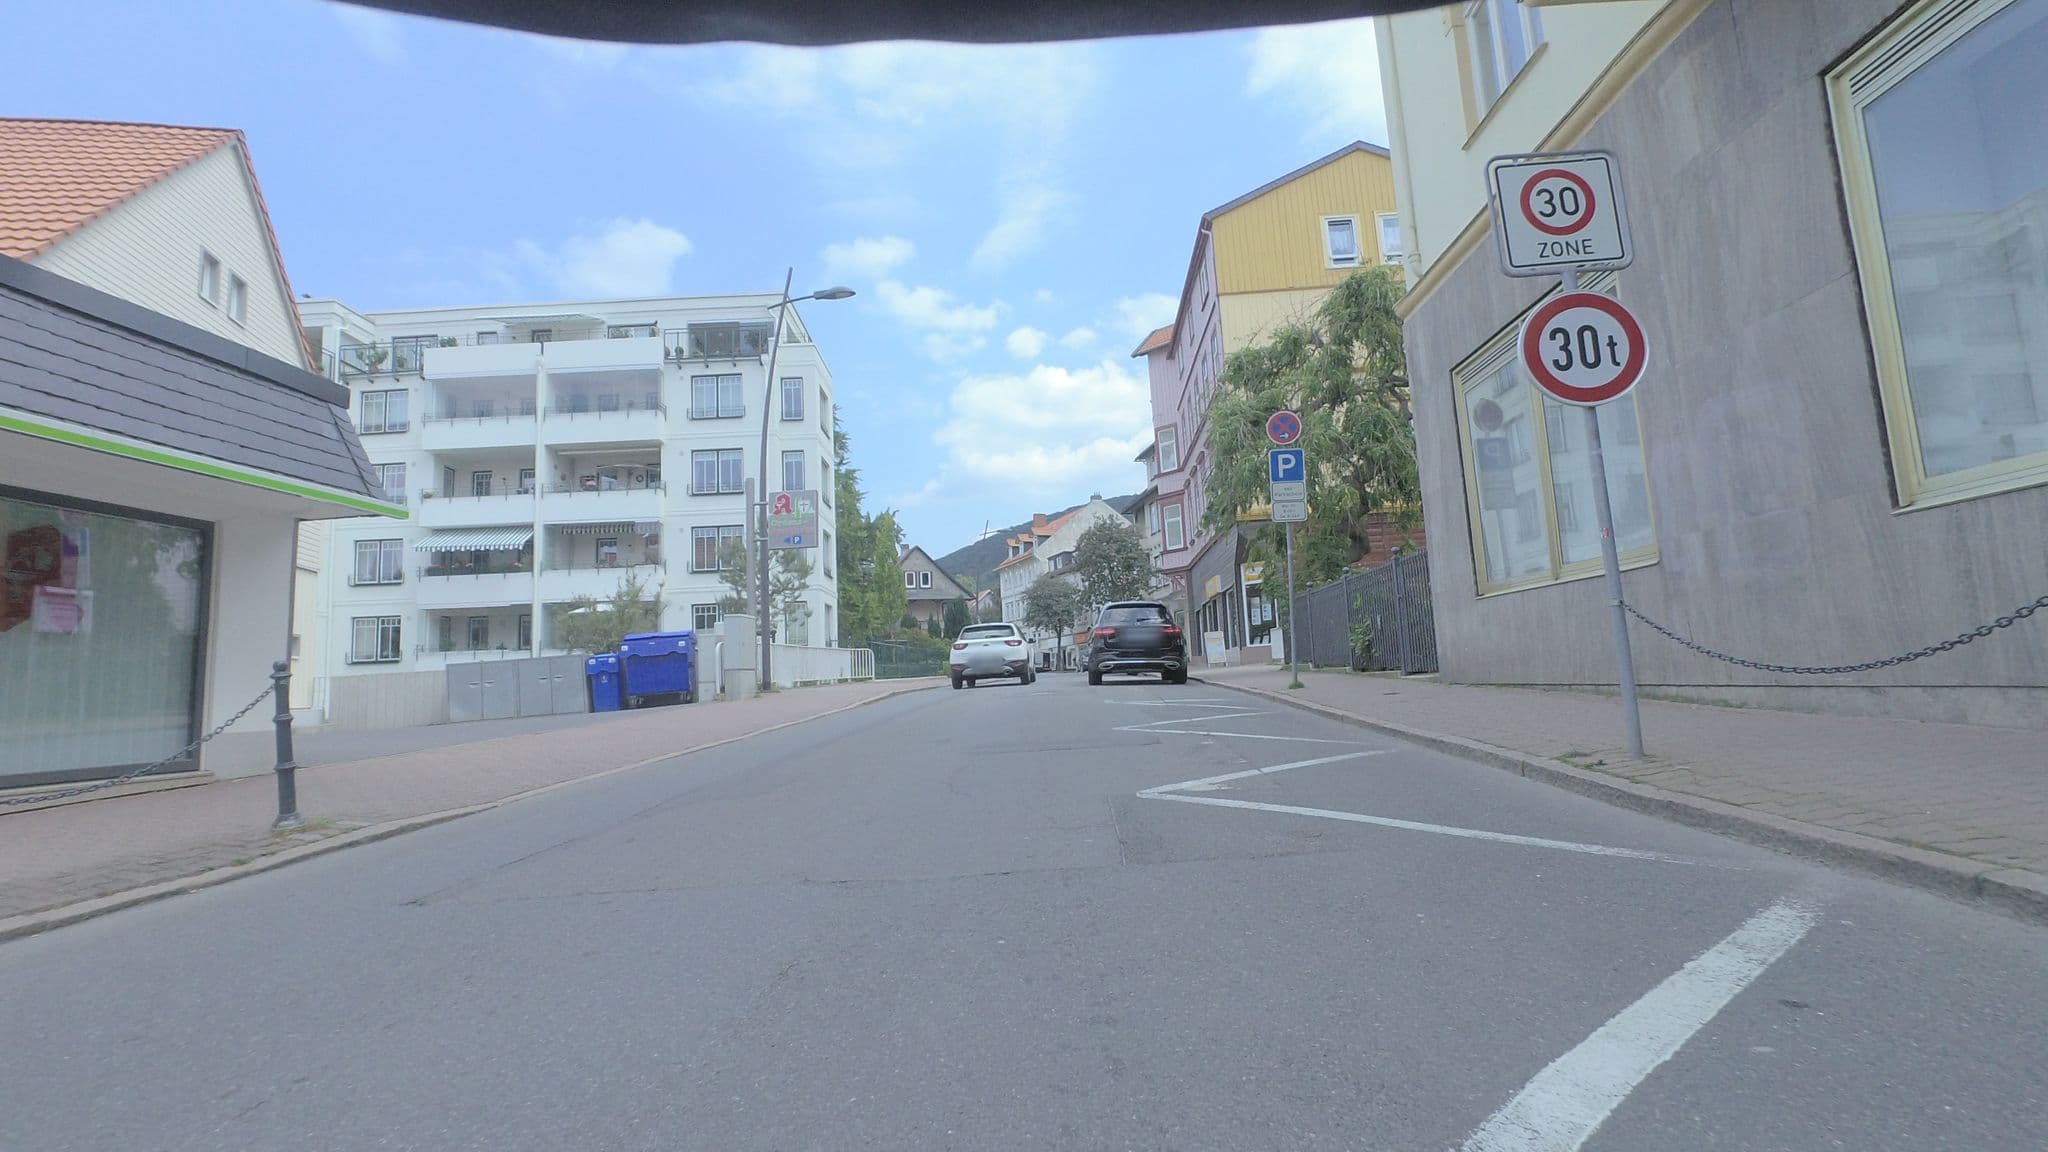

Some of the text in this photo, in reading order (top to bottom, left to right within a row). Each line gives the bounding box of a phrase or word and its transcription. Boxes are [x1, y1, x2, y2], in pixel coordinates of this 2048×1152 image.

[1535, 187, 1580, 218] 30
[1537, 239, 1594, 258] ZONE
[1278, 454, 1296, 478] P
